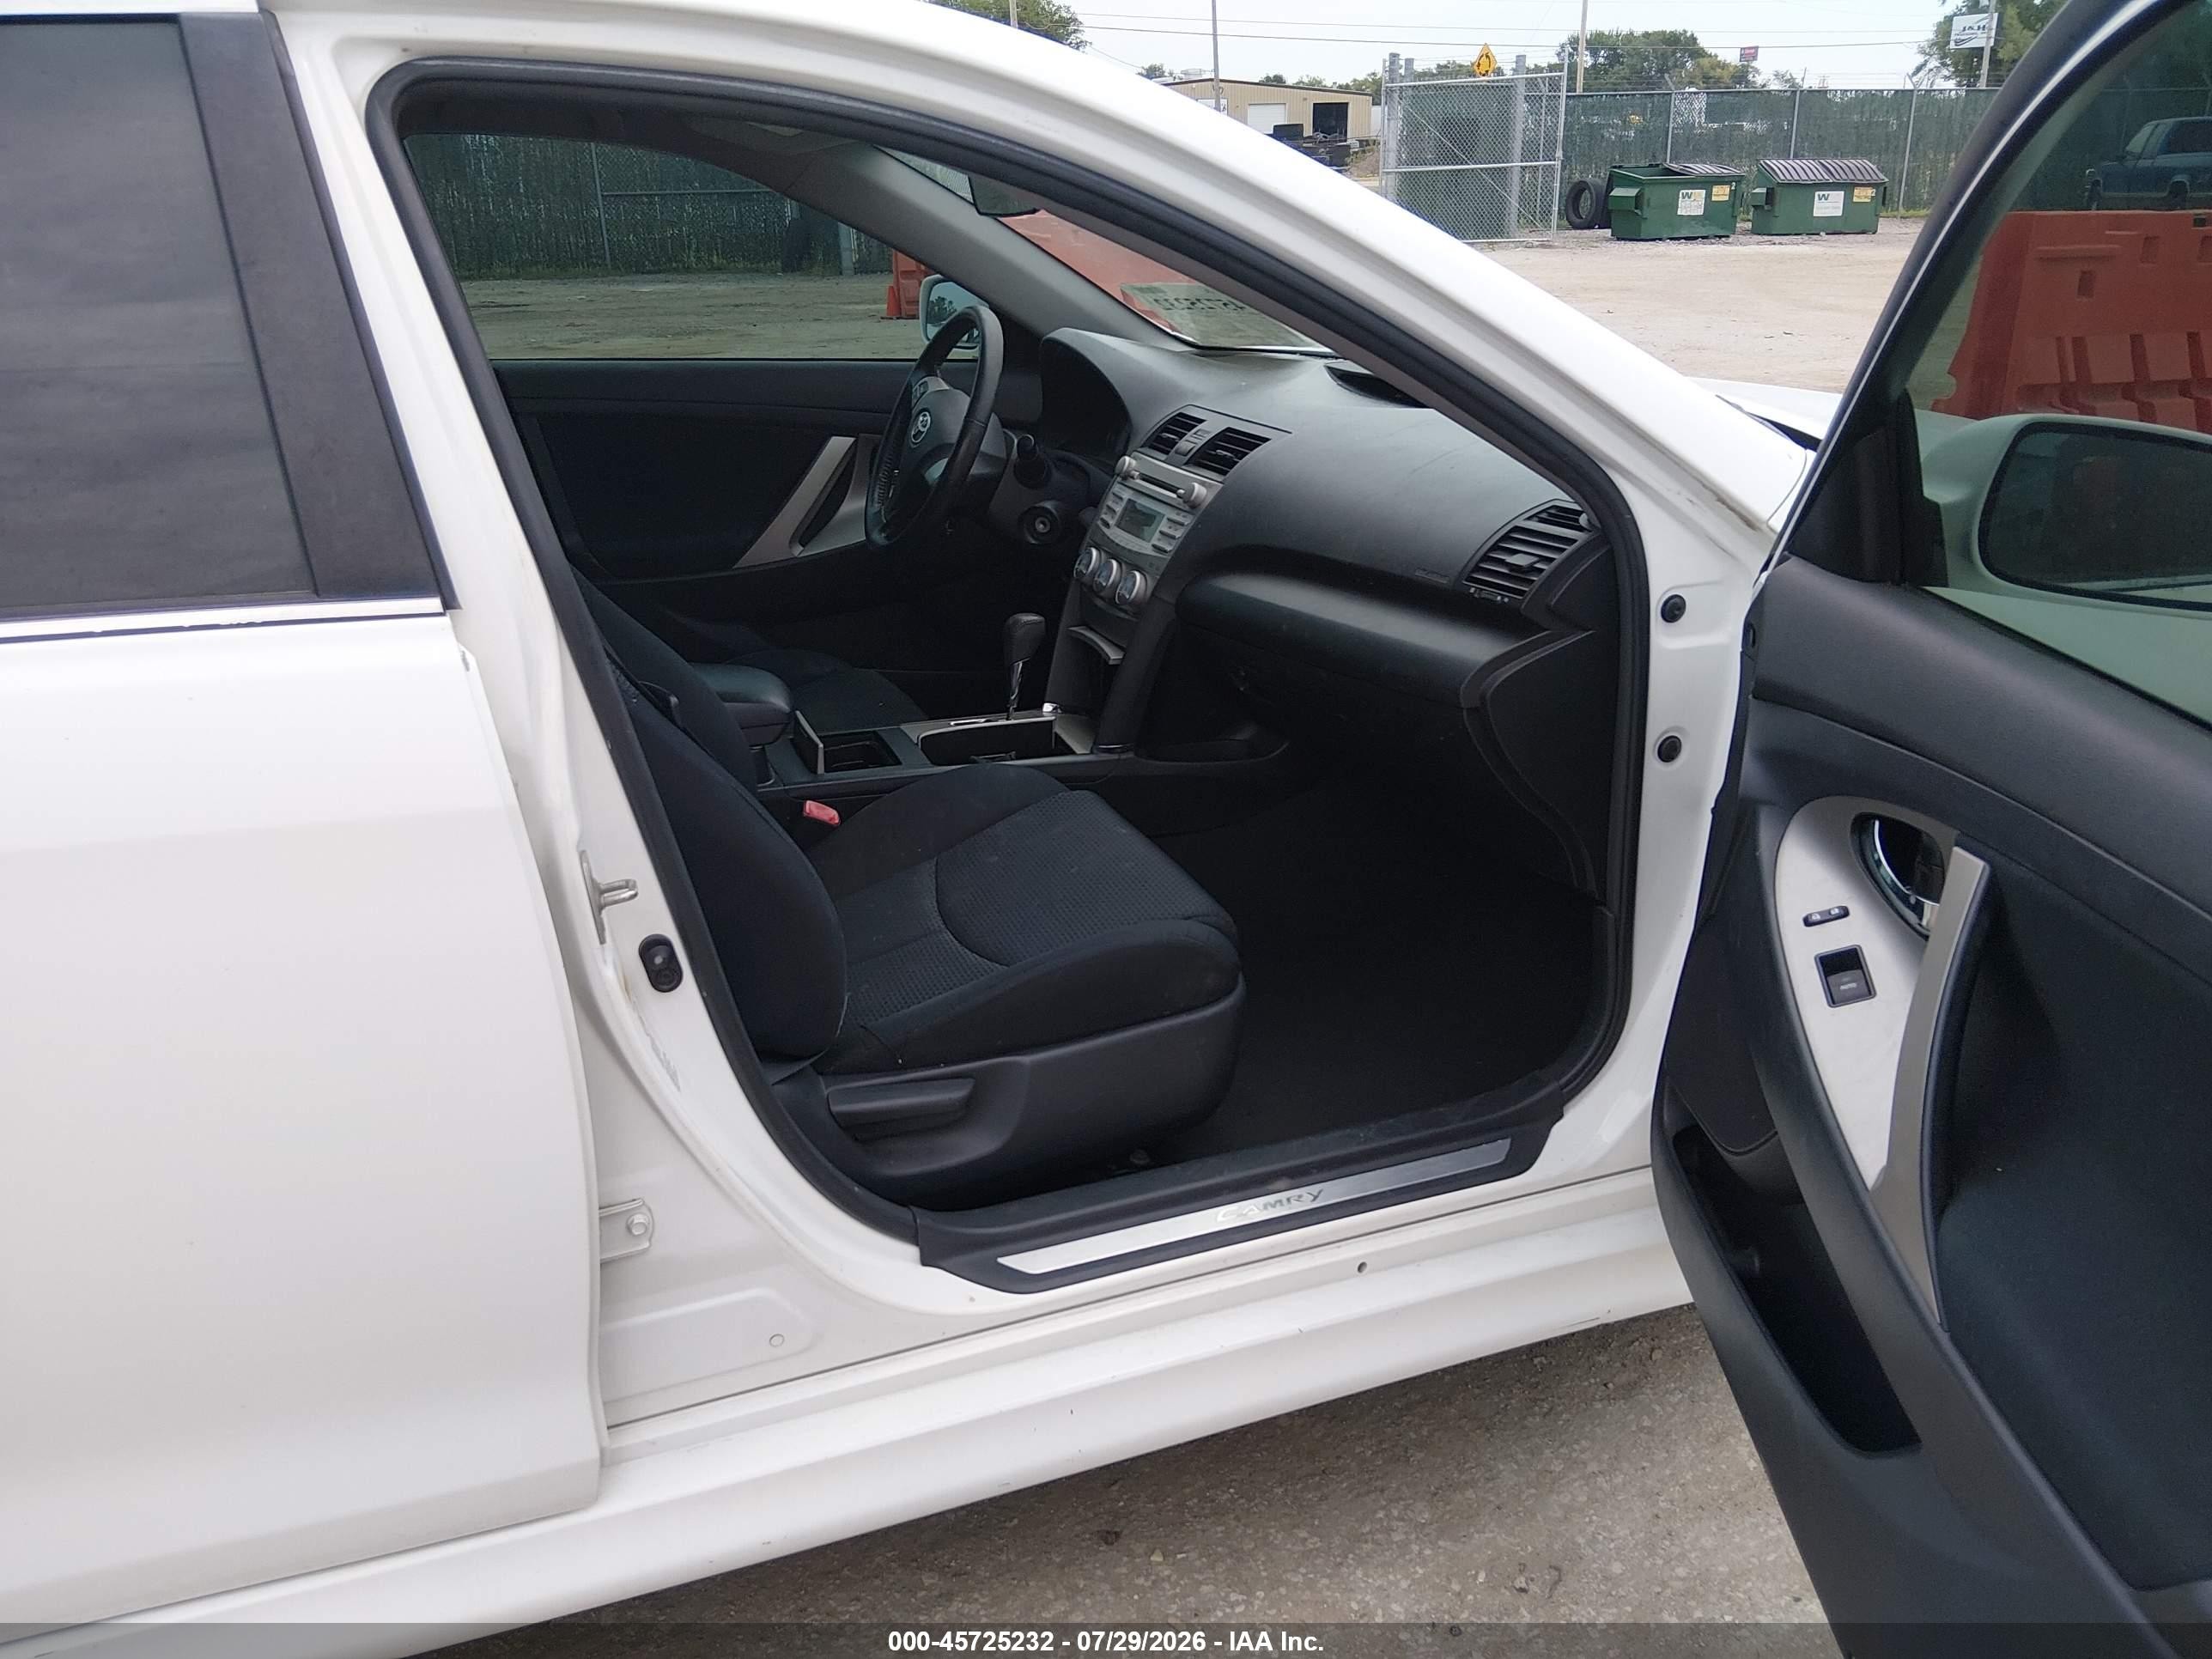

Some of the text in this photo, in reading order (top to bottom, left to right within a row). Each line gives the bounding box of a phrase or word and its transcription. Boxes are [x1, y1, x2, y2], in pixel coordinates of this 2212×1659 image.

[1731, 181, 1736, 190] 2
[1871, 188, 1876, 197] 2
[1216, 1188, 1324, 1222] CAMRY
